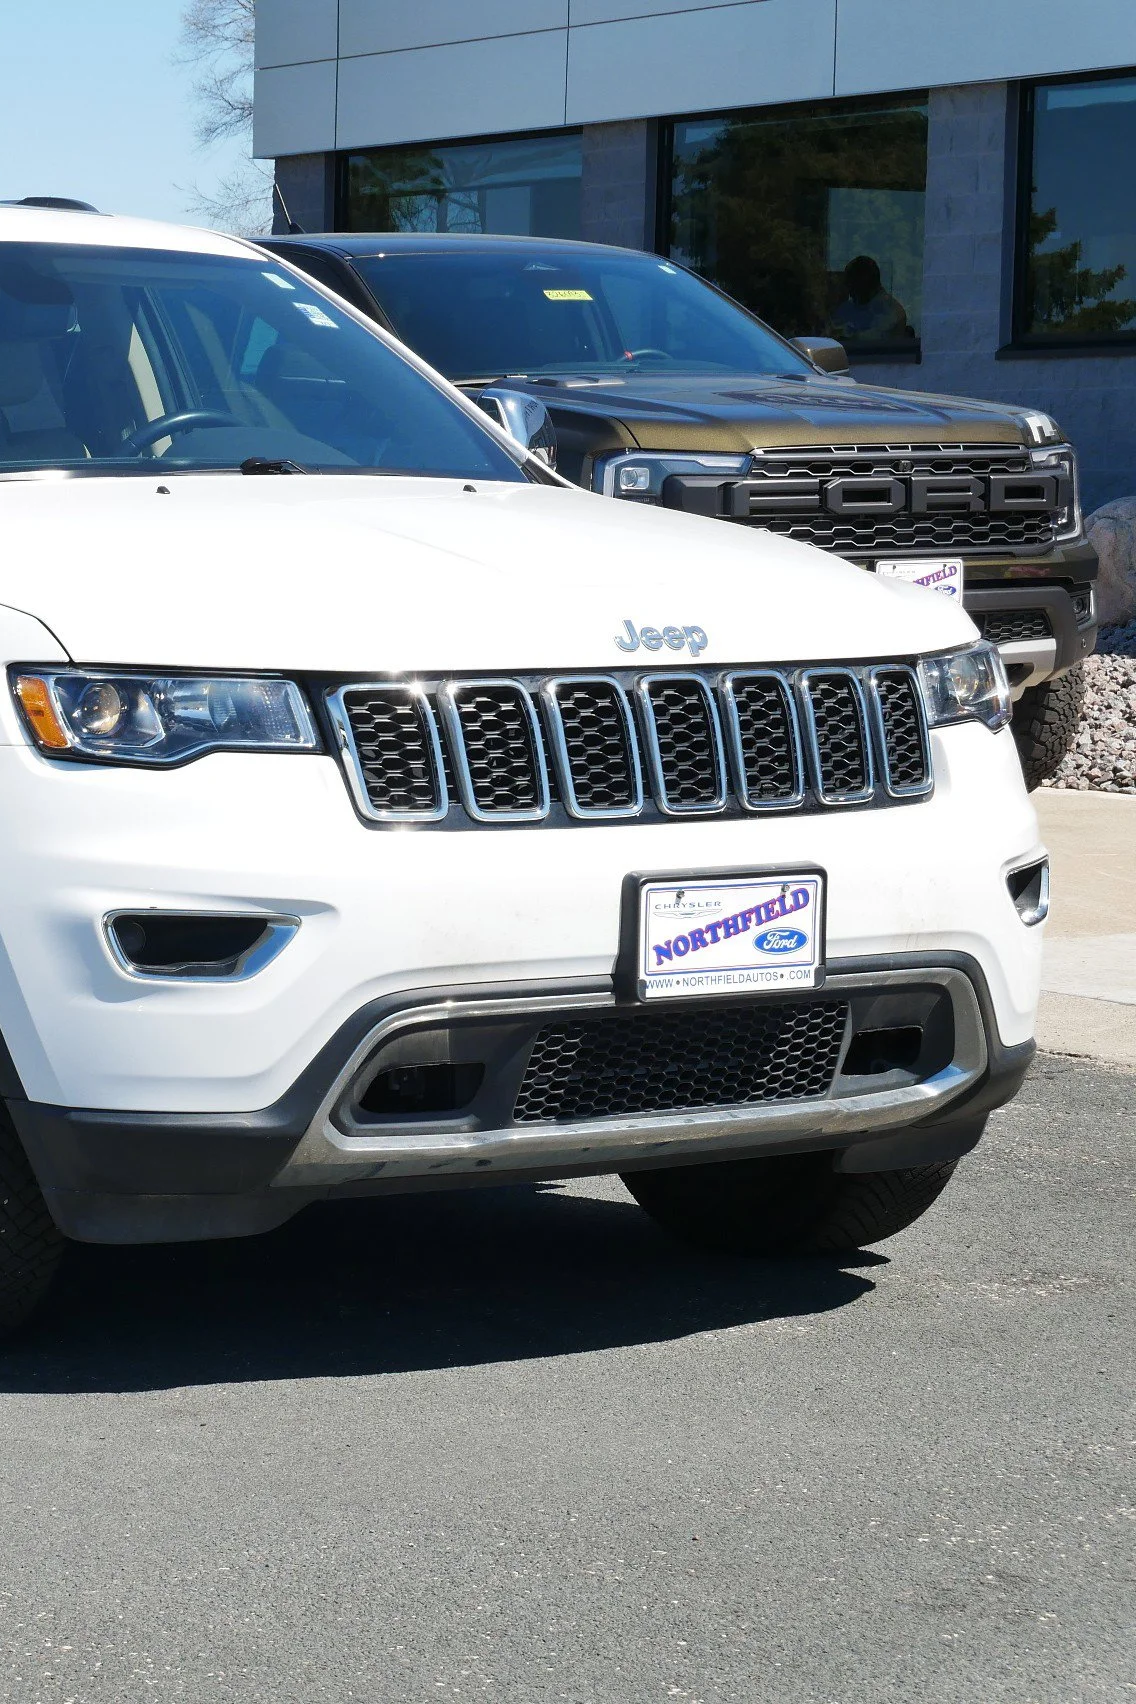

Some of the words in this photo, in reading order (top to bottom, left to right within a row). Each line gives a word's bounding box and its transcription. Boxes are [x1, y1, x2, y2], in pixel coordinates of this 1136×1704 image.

[726, 474, 1059, 515] FORD
[613, 619, 709, 657] Jeep
[654, 901, 722, 910] CHRYSLER
[652, 887, 810, 966] NORTHFIELD
[763, 931, 798, 950] Ford
